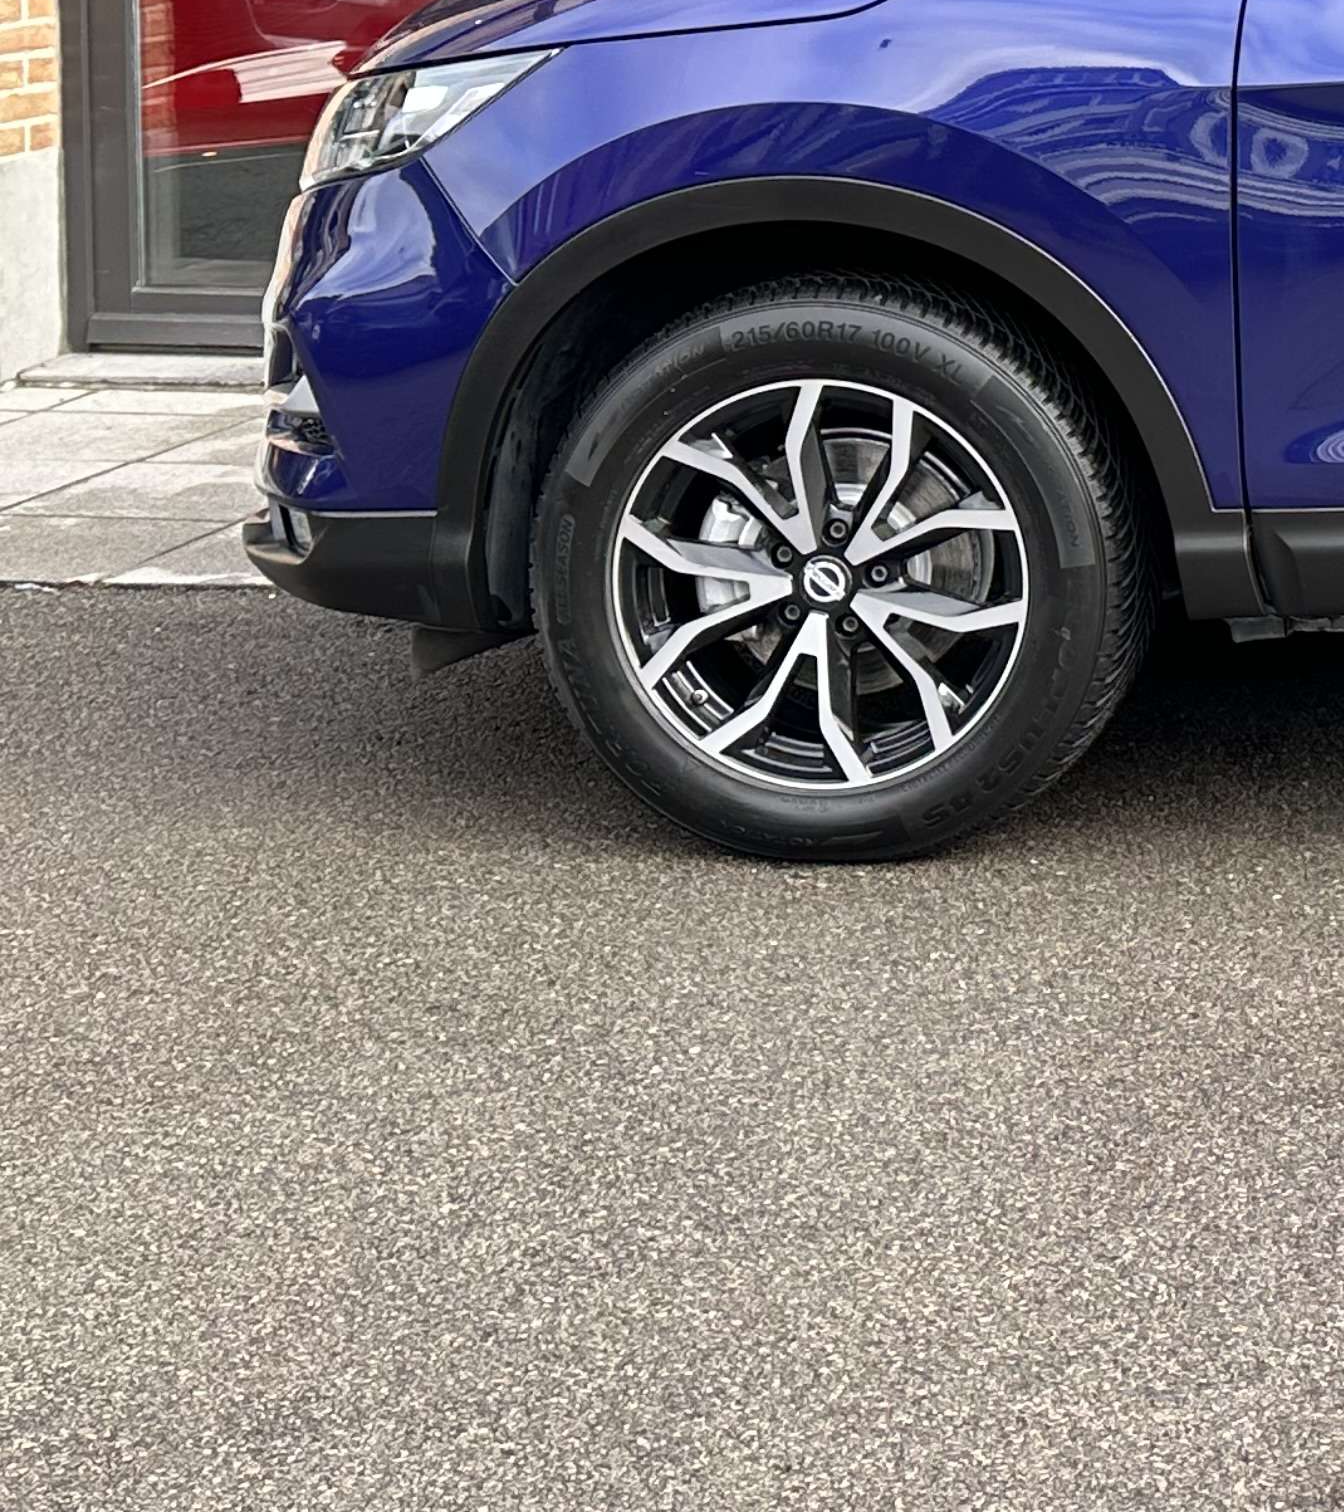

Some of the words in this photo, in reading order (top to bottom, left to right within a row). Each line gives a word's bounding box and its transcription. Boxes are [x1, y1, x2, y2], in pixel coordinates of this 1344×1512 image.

[731, 320, 863, 350] 215/60R17
[871, 328, 929, 360] 100V
[935, 353, 964, 383] XL
